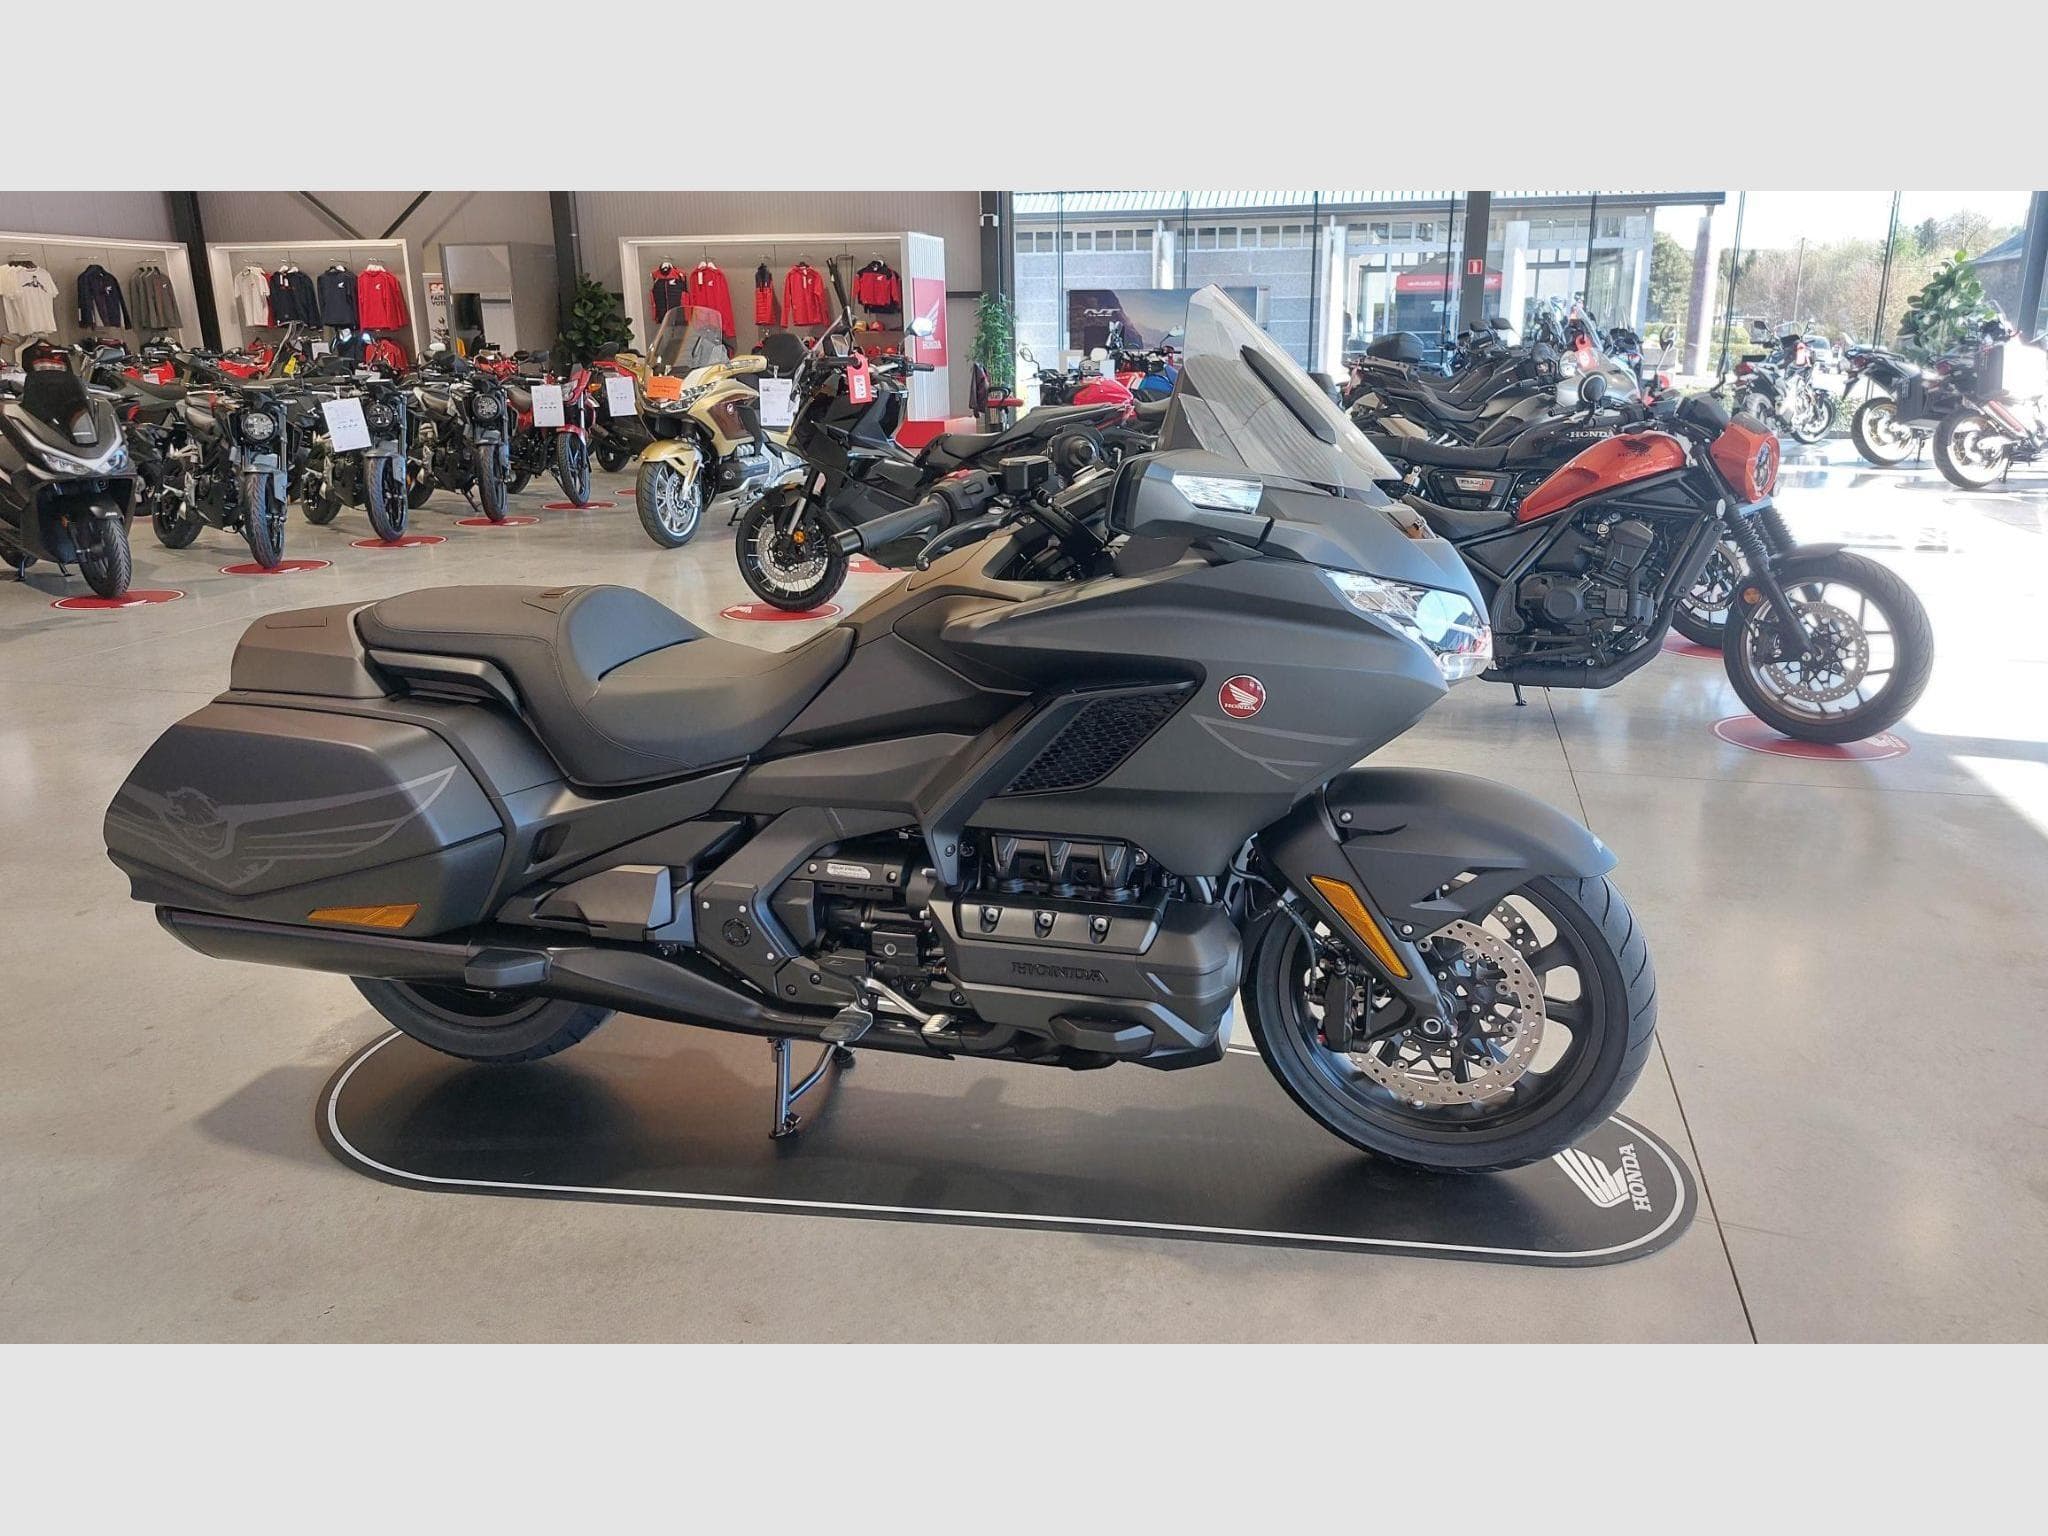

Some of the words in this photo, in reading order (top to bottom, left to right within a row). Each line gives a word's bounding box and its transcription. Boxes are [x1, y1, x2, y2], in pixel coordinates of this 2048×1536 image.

[1224, 703, 1256, 711] HONDA
[1011, 962, 1109, 983] HONDA
[1619, 1143, 1653, 1213] HONDA
